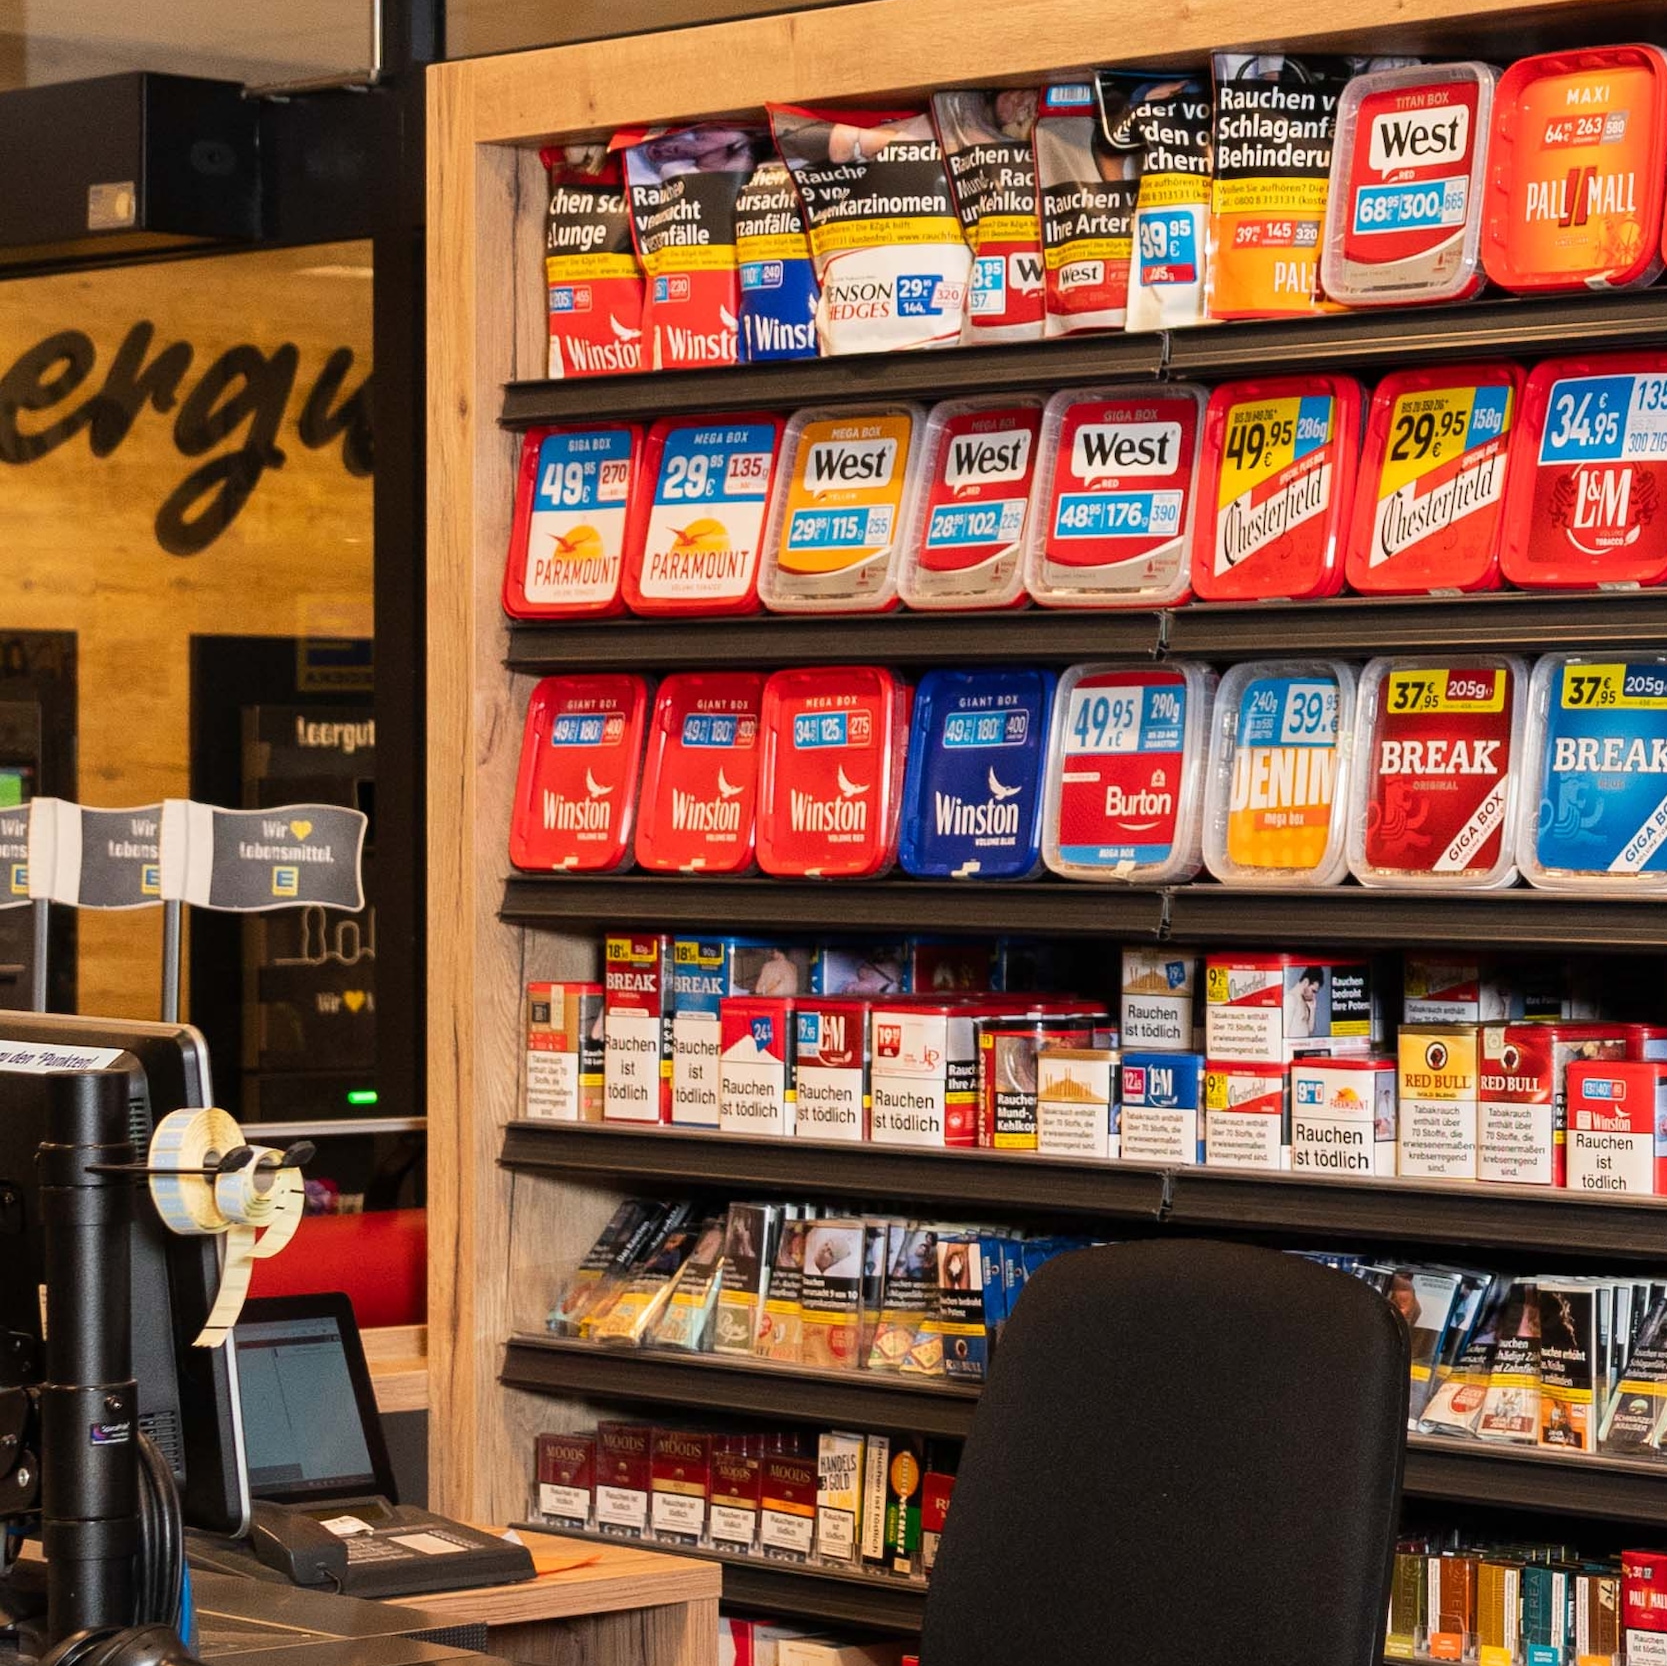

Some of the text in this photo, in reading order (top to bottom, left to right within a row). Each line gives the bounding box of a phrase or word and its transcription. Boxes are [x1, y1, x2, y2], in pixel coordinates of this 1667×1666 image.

[1220, 88, 1309, 113] Rauchen
[1567, 87, 1609, 105] MAXI
[1381, 115, 1459, 158] West
[1526, 171, 1636, 223] PALL MALL
[816, 444, 889, 481] West
[955, 438, 1022, 475] West
[1084, 427, 1169, 468] West
[1379, 461, 1495, 559] Chesterfield
[1575, 462, 1631, 525] L&M
[1224, 463, 1323, 563] Chesterfield
[534, 554, 618, 587] PARAMOUNT
[650, 549, 748, 581] PARAMOUNT
[1380, 740, 1499, 775] BREAK
[1232, 747, 1337, 811] DENIM
[544, 790, 611, 832] Winston
[672, 789, 741, 832] Winston
[791, 791, 868, 832] Winston
[936, 791, 1019, 837] Winston
[1107, 785, 1171, 817] Burton
[605, 1036, 656, 1055] Rauchen
[621, 1059, 636, 1077] ist
[1405, 1074, 1471, 1091] RED BULL
[609, 1082, 649, 1101] tödlich
[1295, 1123, 1363, 1147] Rauchen
[1293, 1149, 1369, 1170] ist tödlich
